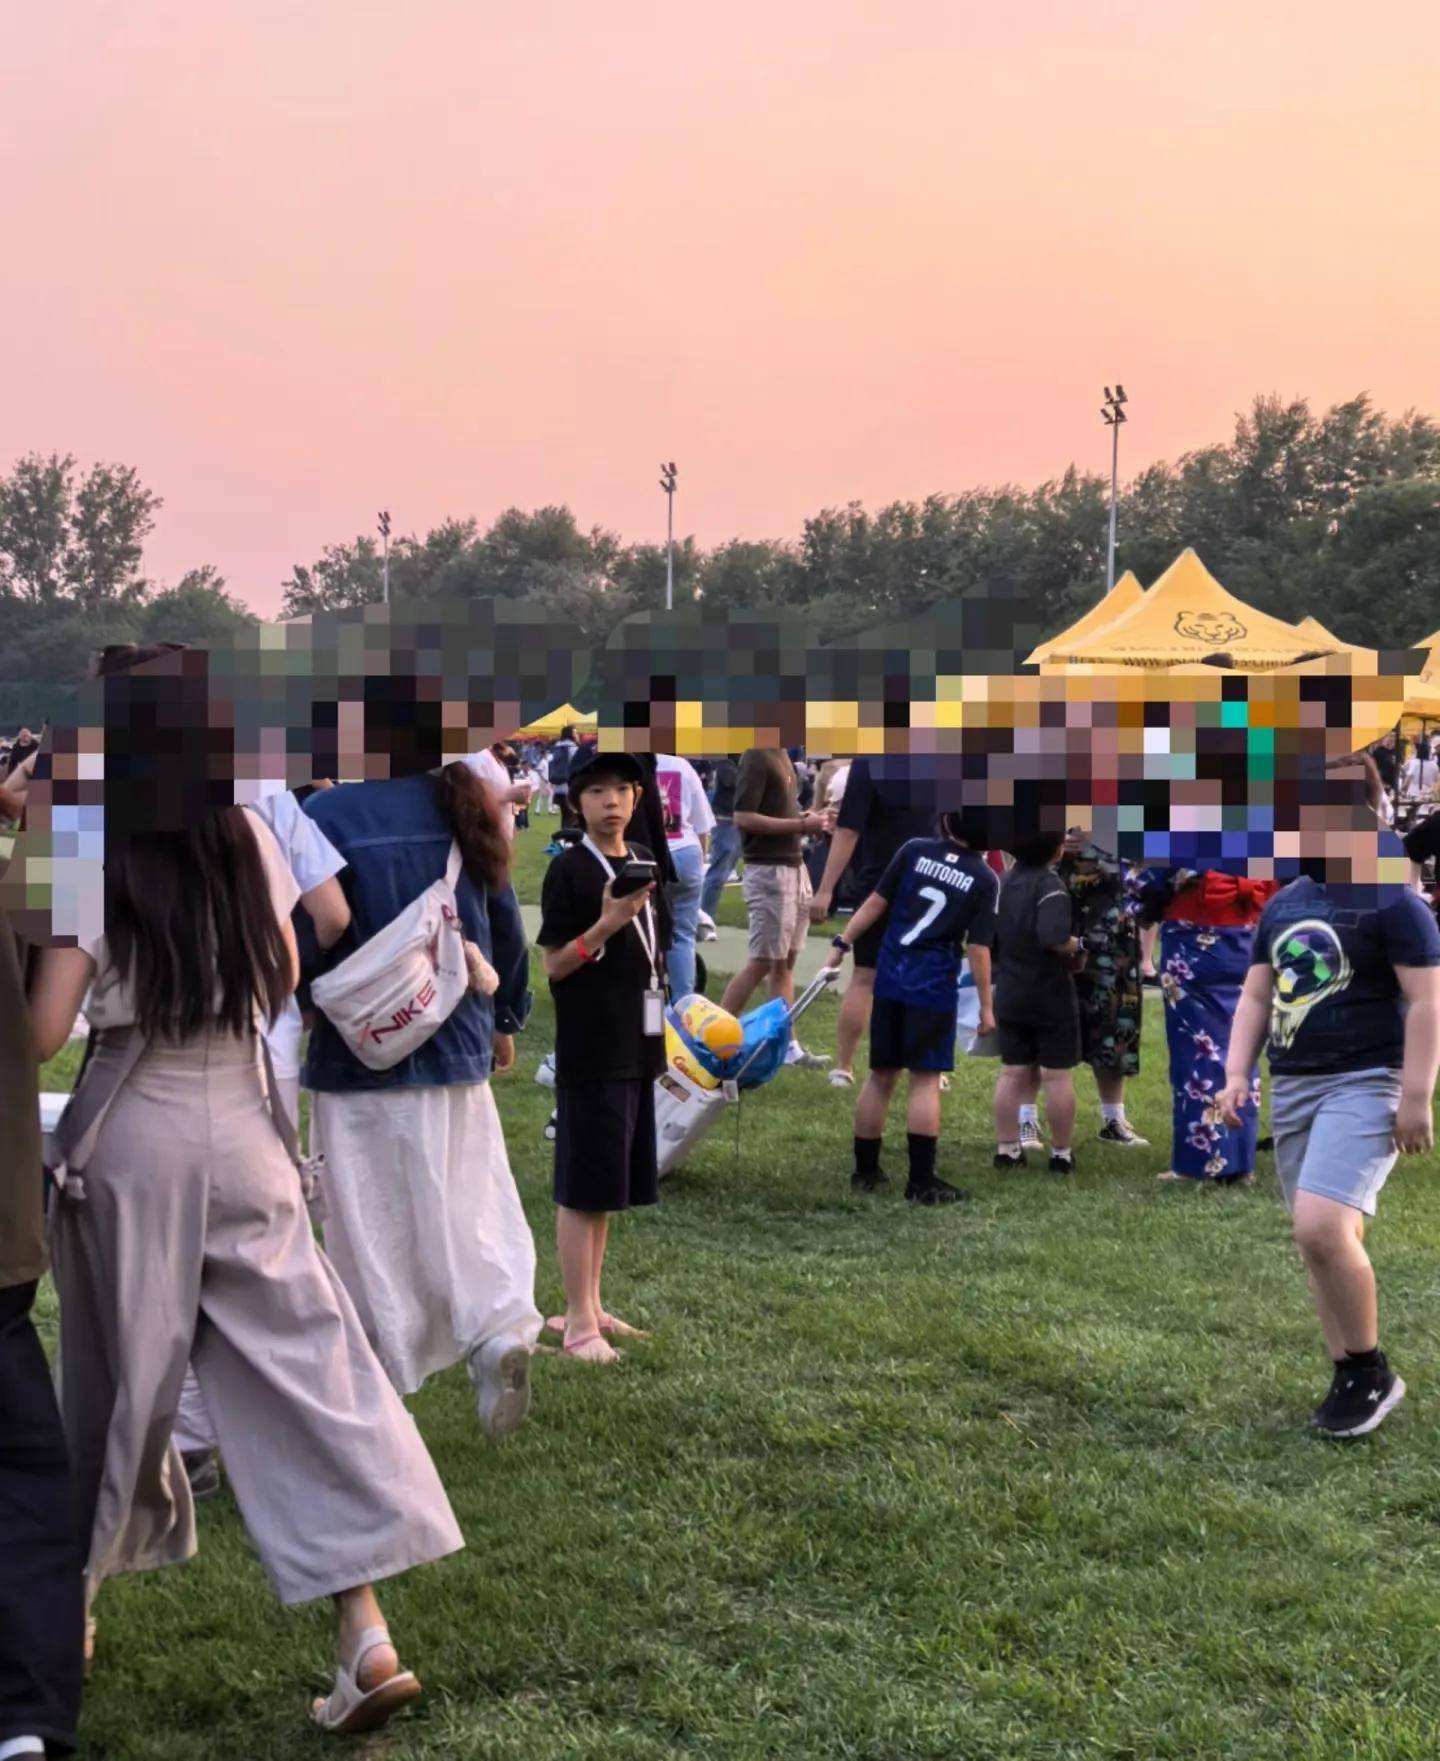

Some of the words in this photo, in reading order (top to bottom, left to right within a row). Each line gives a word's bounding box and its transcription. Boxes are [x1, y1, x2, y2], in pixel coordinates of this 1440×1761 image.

[914, 856, 974, 892] MITOMA
[900, 886, 947, 946] 7
[370, 979, 436, 1044] NIKE
